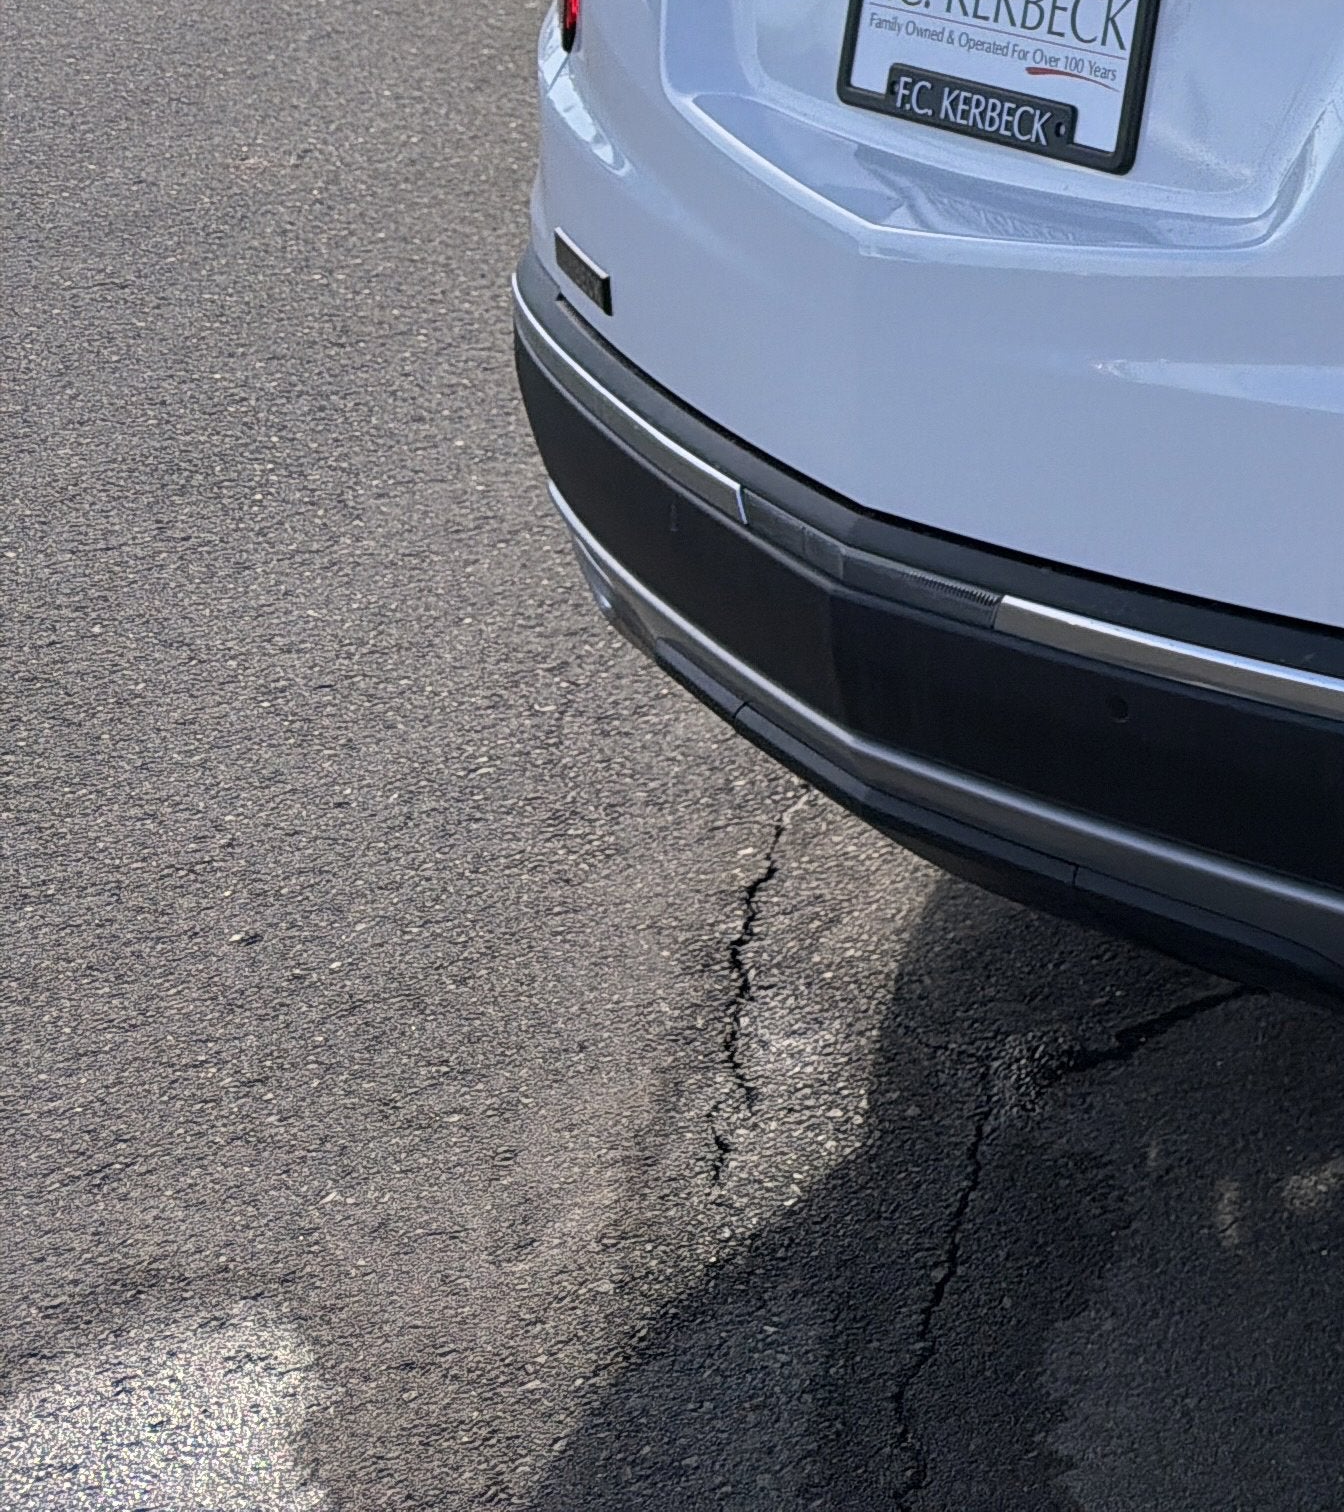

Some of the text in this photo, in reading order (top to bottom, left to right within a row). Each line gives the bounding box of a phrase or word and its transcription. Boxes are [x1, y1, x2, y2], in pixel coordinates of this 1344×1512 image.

[869, 12, 1118, 82] Family Owned & Operated For Over 100 Years
[895, 76, 1052, 146] F.C. KERBECK
